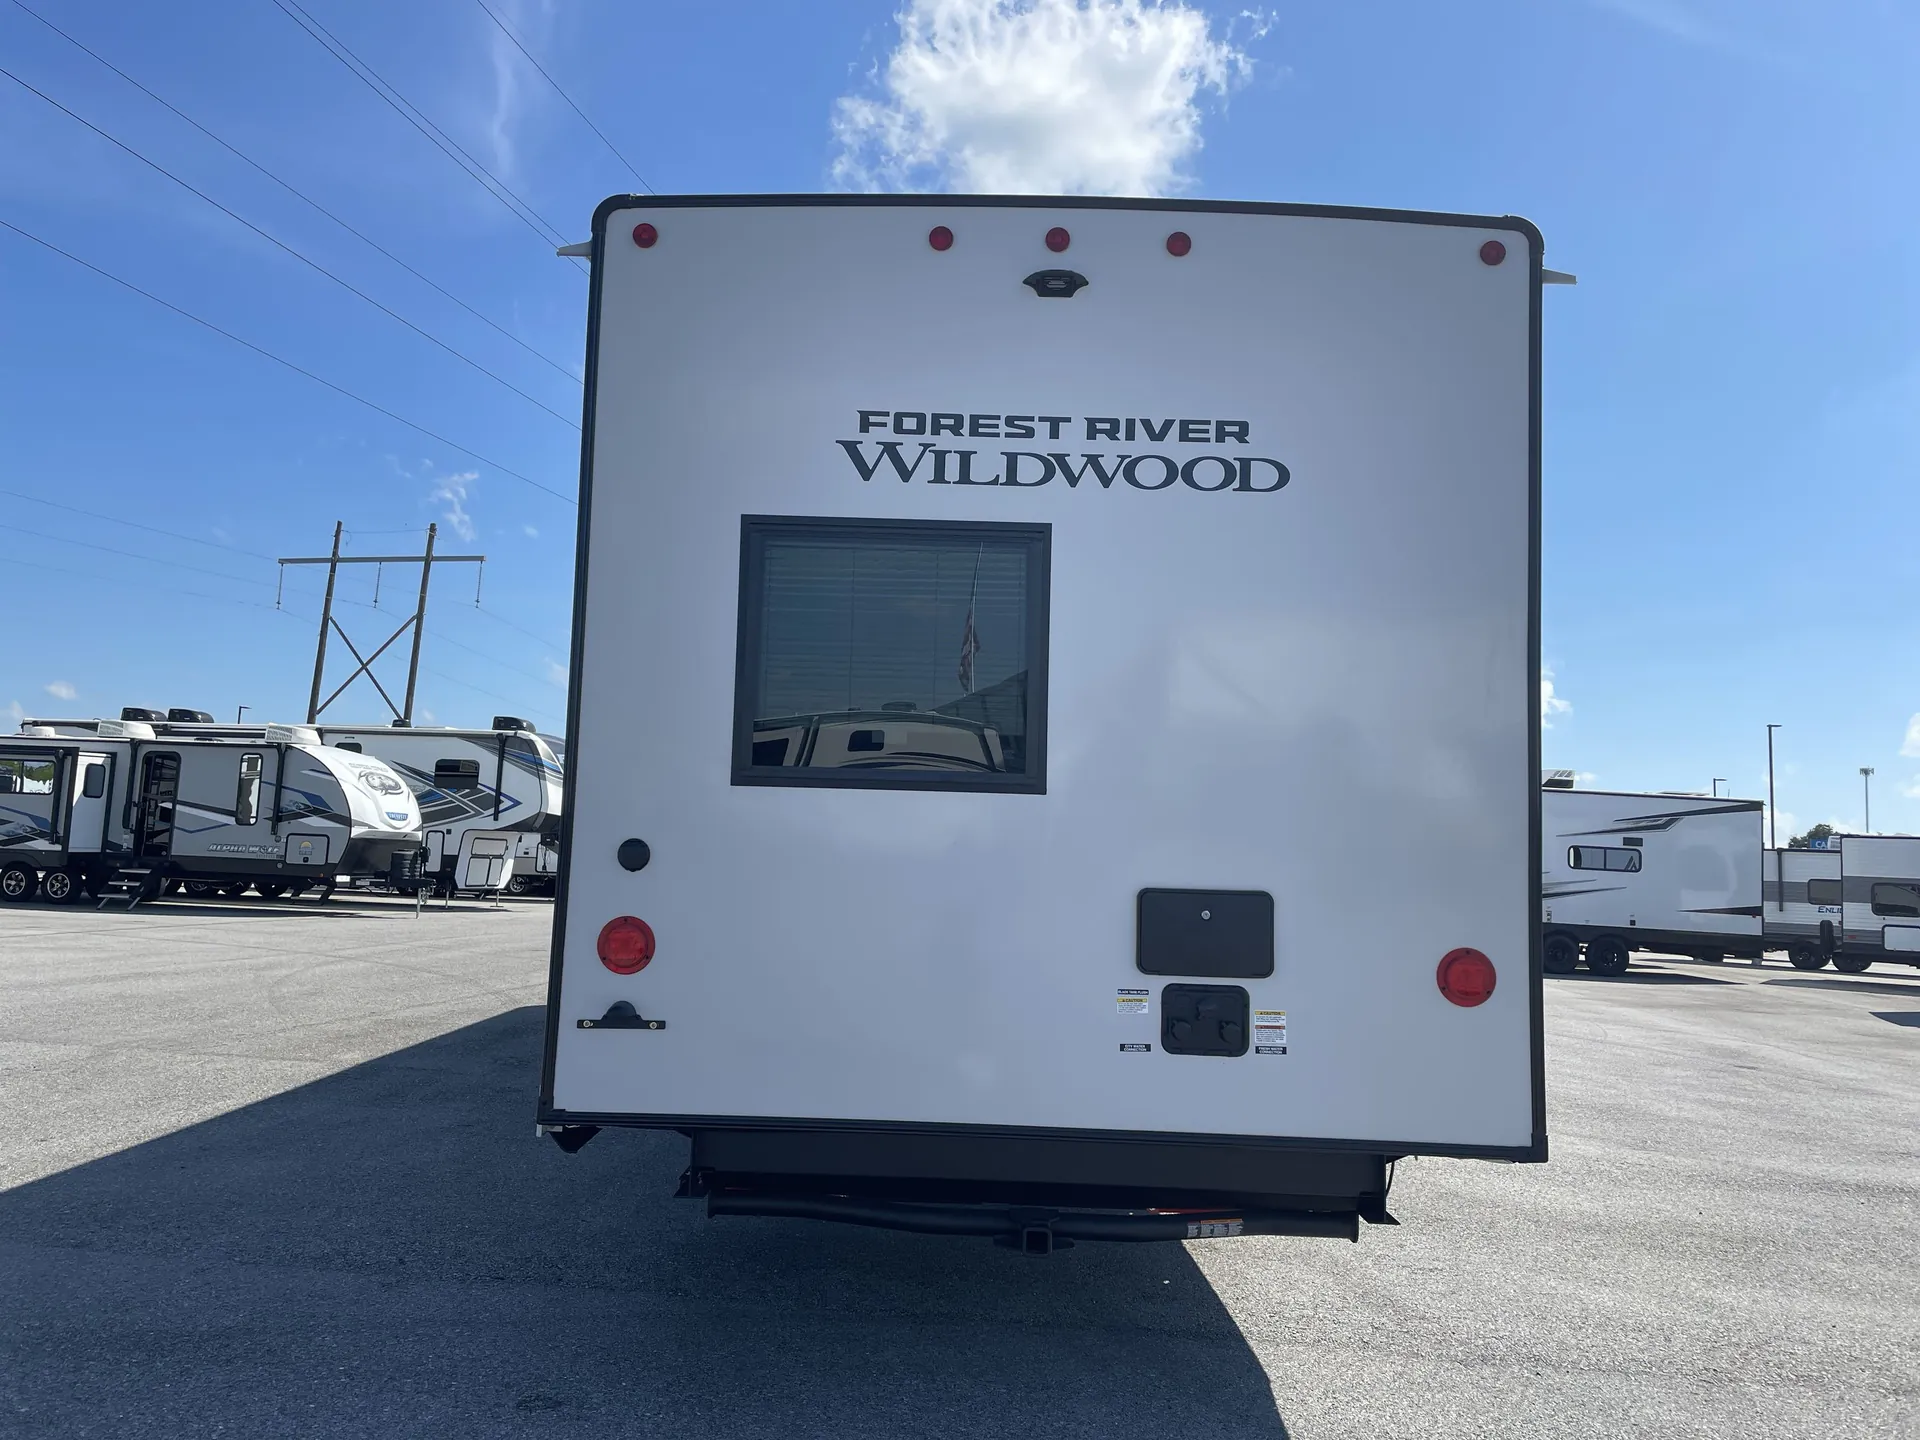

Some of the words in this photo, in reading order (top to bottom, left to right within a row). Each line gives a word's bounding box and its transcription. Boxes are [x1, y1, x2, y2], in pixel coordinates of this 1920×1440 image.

[856, 410, 1072, 440] FOREST
[1084, 417, 1250, 444] RIVER
[836, 440, 1290, 492] WILDWOOD
[207, 843, 247, 853] ALPHA
[1815, 840, 1827, 848] CA
